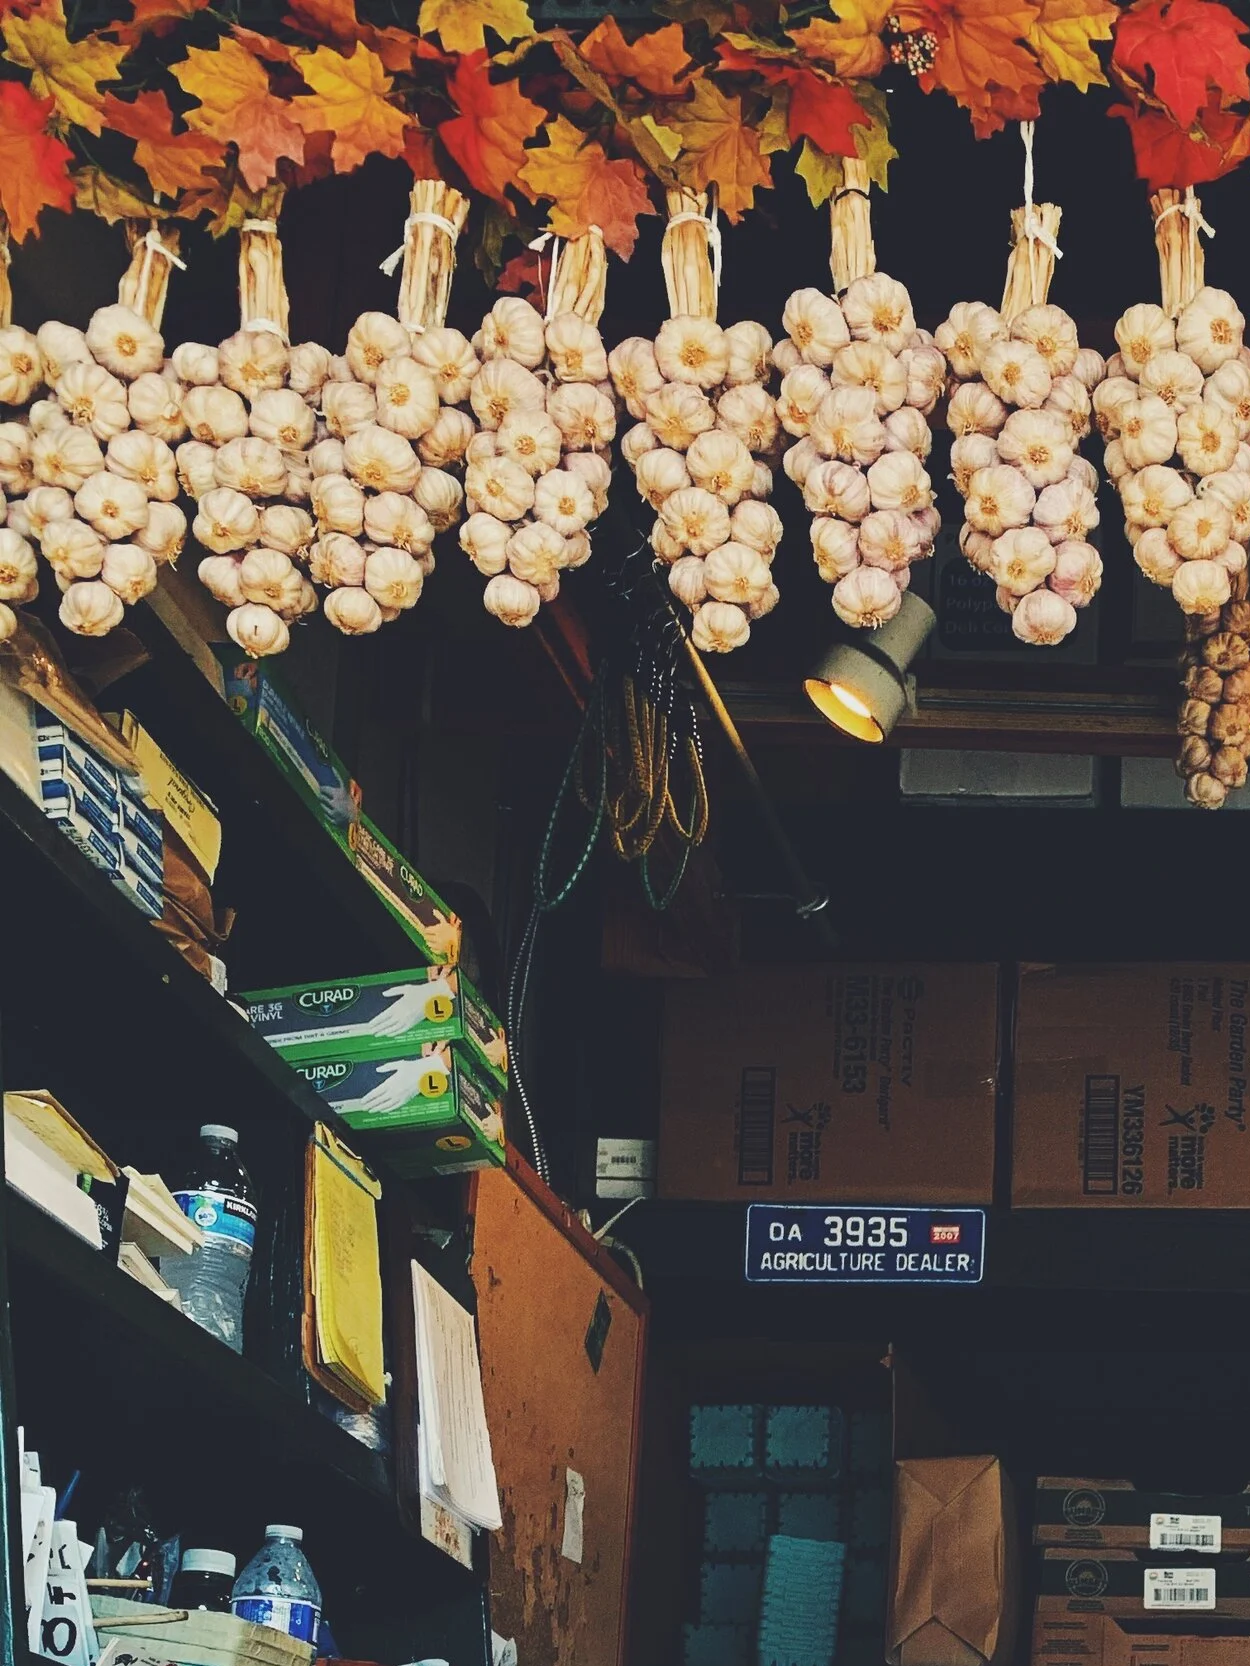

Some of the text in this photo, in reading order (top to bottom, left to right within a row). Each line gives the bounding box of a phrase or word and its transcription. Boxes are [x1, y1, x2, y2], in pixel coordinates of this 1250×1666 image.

[299, 988, 354, 1008] CURAD
[433, 1001, 445, 1015] L
[1229, 980, 1249, 1008] The
[842, 975, 870, 1094] M33-6153
[1229, 1013, 1249, 1073] Garden
[428, 1075, 439, 1090] L
[799, 1132, 814, 1180] more
[1121, 1085, 1146, 1195] YM336126
[1181, 1136, 1197, 1190] more
[823, 1216, 908, 1248] 3935
[932, 1232, 960, 1241] 2007
[760, 1252, 970, 1272] AGRICULTURE DEALER
